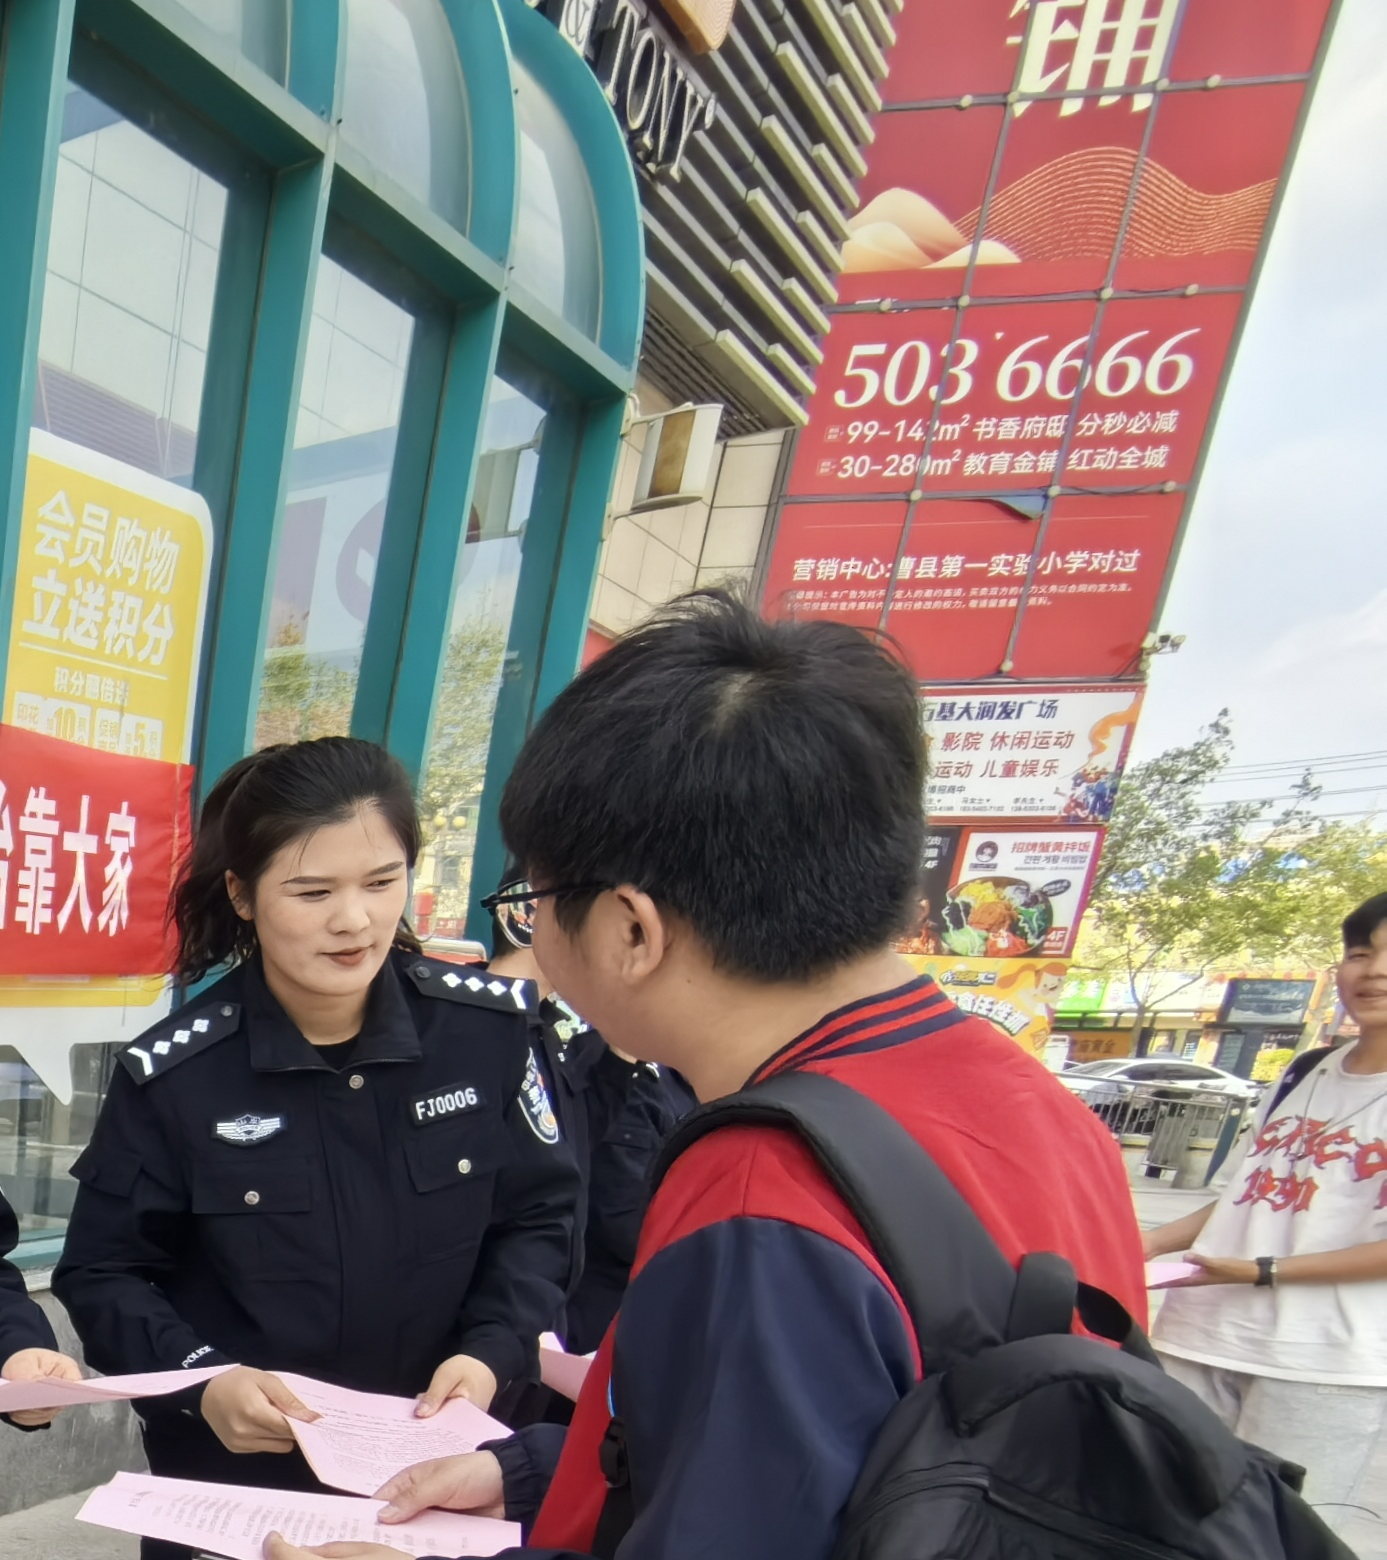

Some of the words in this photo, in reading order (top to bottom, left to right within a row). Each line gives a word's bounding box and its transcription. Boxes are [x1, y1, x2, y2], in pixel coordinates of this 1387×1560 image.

[1076, 410, 1178, 436] 分秒必减
[1066, 445, 1170, 470] 红动全城
[33, 490, 180, 595] 会员购物
[22, 570, 176, 667] 立送积分
[941, 731, 984, 751] 影院
[990, 730, 1074, 750] 休闲运动
[980, 759, 1059, 778] 儿童娱乐
[415, 1087, 477, 1120] FJ0006
